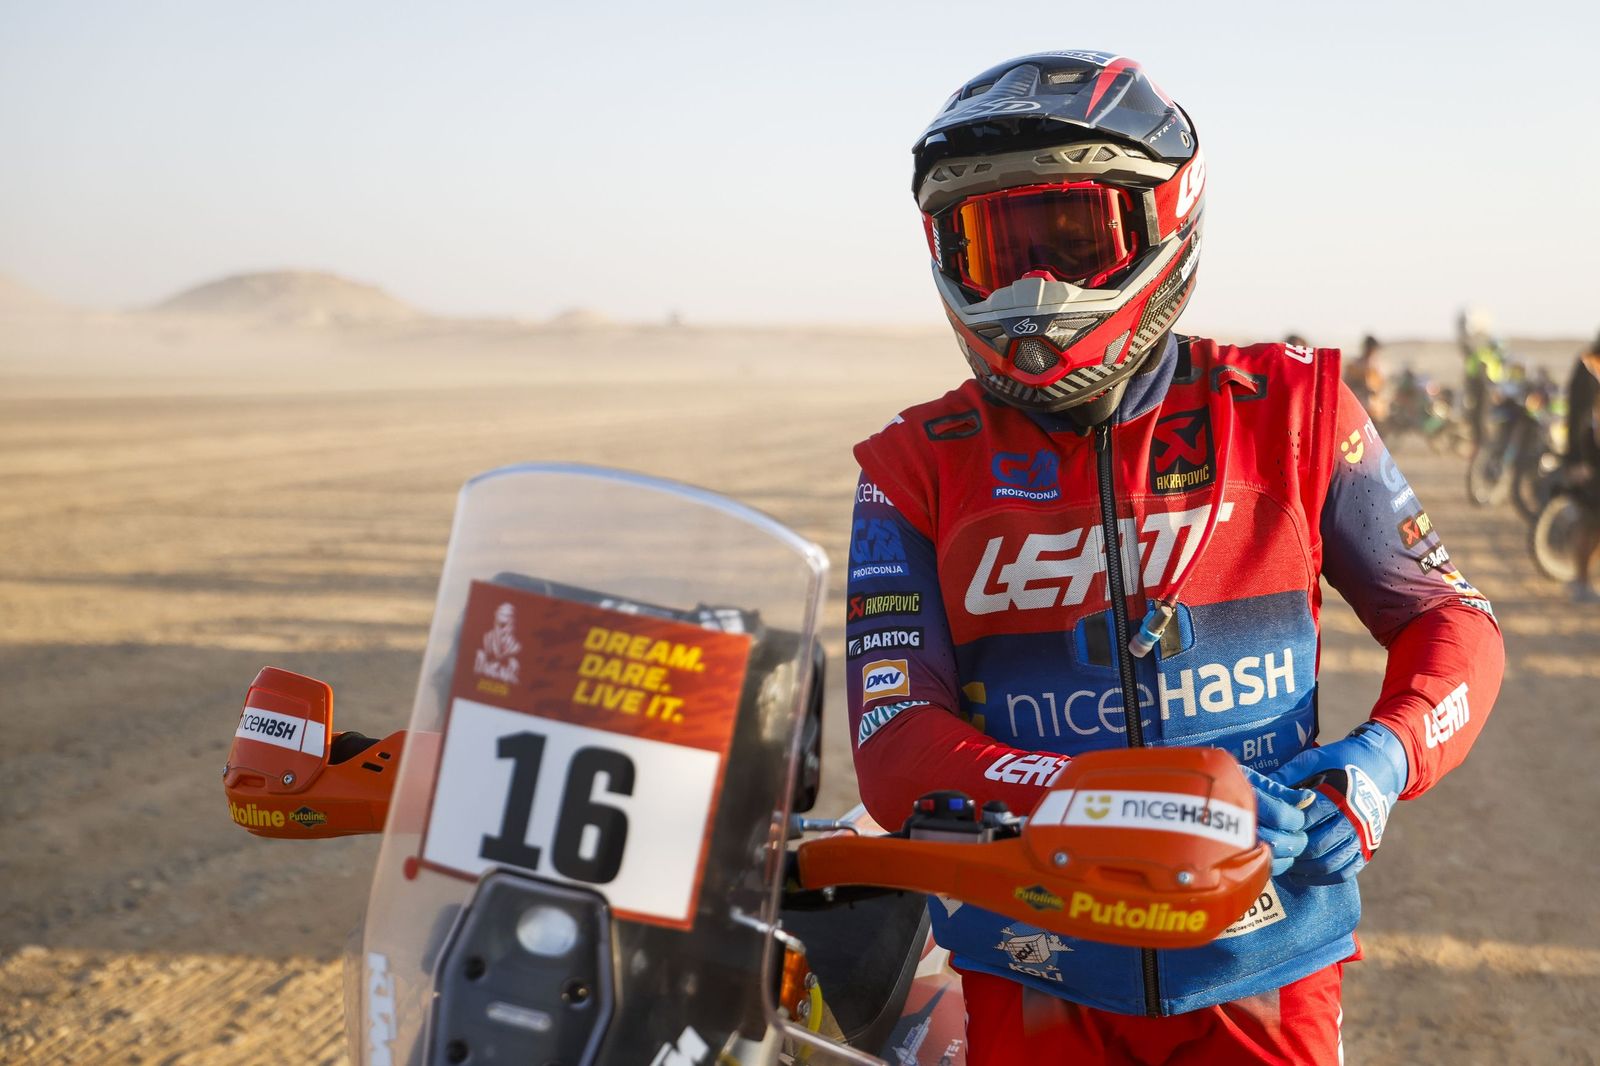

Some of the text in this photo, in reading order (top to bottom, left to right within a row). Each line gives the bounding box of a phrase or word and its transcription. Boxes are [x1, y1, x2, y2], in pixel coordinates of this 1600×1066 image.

[1012, 318, 1038, 335] 6D
[995, 488, 1058, 500] PROIZVODNJA
[853, 565, 903, 579] PROIZODNJA
[583, 627, 705, 673] DREAM.
[863, 631, 920, 650] BARTOG
[577, 653, 672, 694] DARE.
[866, 671, 902, 690] DKV
[572, 680, 684, 724] LIVE IT.
[1243, 732, 1277, 761] BIT
[1249, 758, 1279, 770] olding
[478, 730, 636, 885] 16
[1069, 891, 1208, 932] Putoline
[1236, 892, 1274, 923] BD
